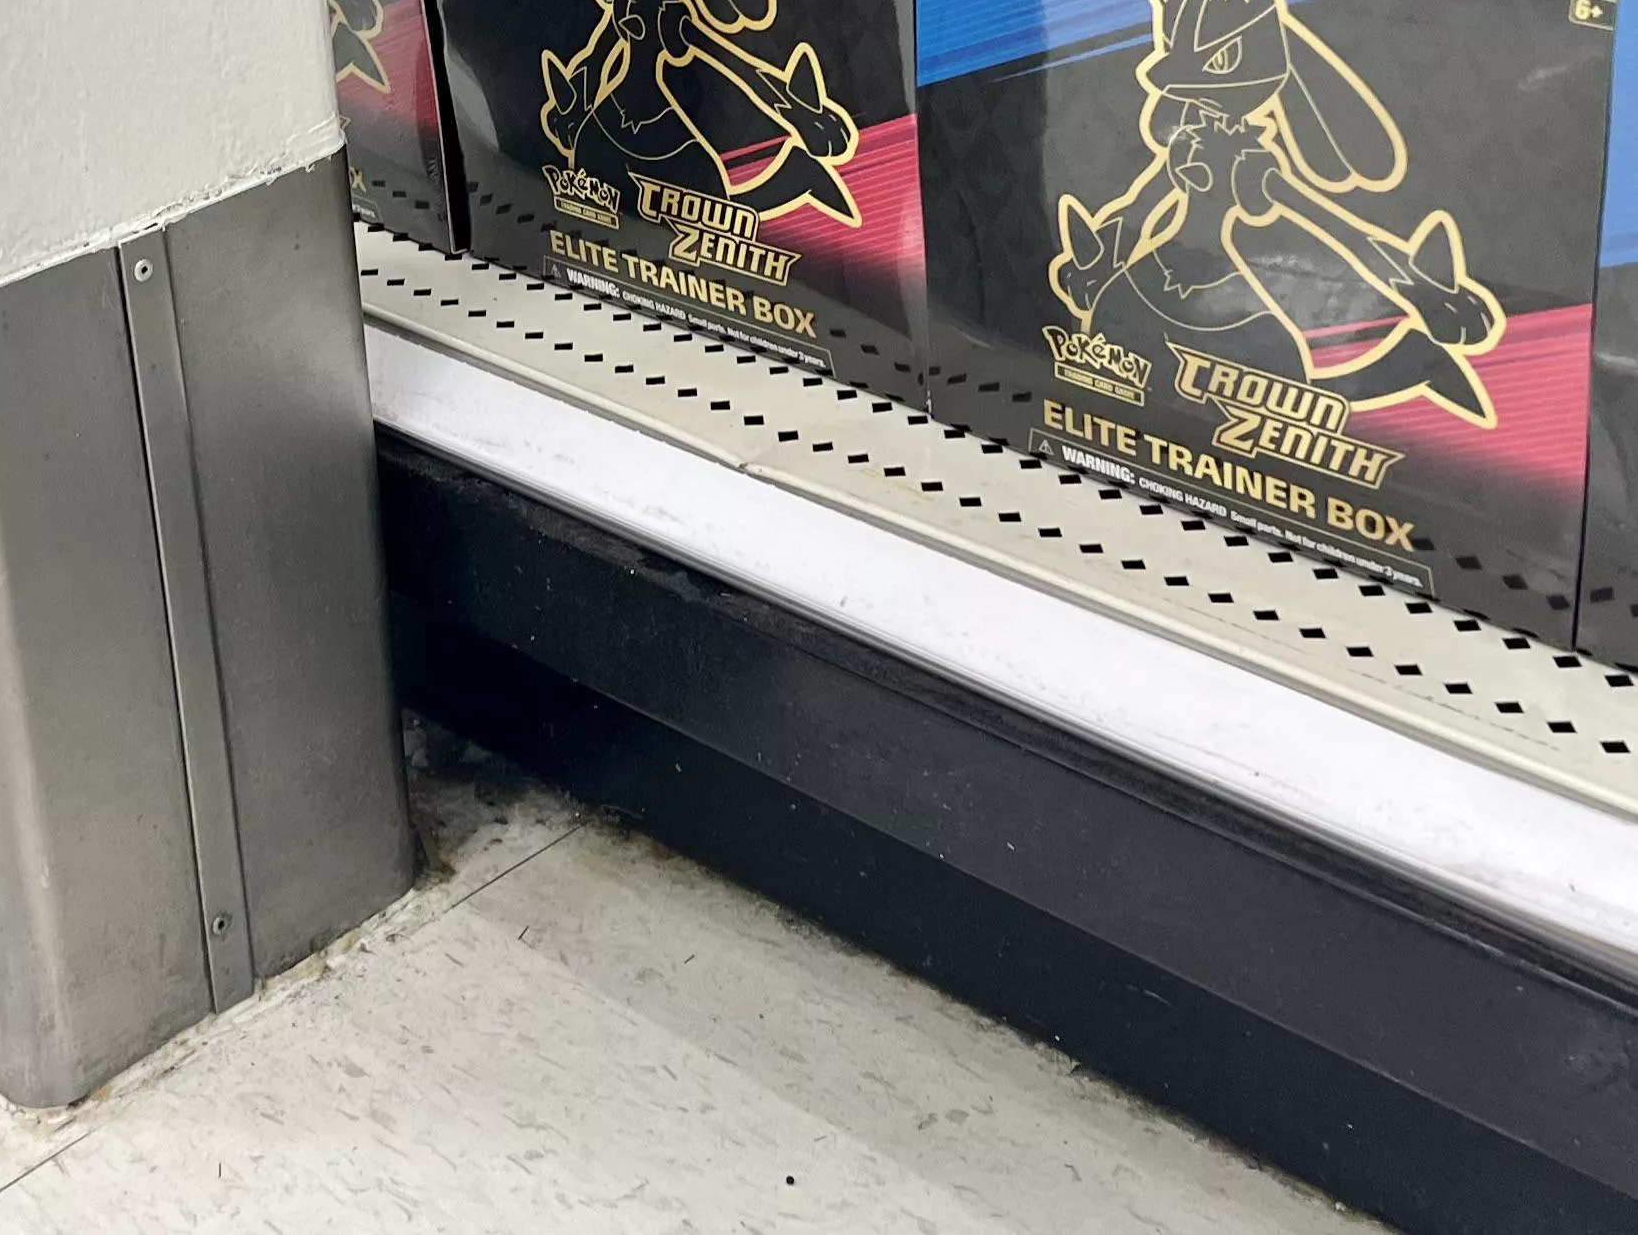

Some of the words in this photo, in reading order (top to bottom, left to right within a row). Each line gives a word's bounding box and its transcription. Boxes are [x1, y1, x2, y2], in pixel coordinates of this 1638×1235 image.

[638, 180, 759, 239] CROWN
[550, 230, 619, 273] ELITE
[622, 254, 747, 316] TRAINER
[753, 295, 816, 338] BOX
[672, 226, 791, 282] ZENITH
[566, 268, 620, 298] WARNING:
[655, 302, 686, 319] HAZARD
[1180, 352, 1347, 433] CROWN
[1043, 399, 1136, 457] ELITE
[1144, 434, 1315, 519] TRAINER
[1327, 496, 1415, 552] BOX
[1218, 408, 1386, 483] ZENITH
[1061, 445, 1136, 485] WARNING:
[1138, 477, 1183, 501] CHOKING
[1185, 492, 1227, 518] HAZARD
[1230, 510, 1256, 528] Small
[1257, 521, 1283, 538] parts.
[1284, 529, 1302, 544] Not
[1302, 537, 1317, 549] for
[1316, 541, 1356, 563] children
[1356, 557, 1383, 574] under
[1394, 571, 1423, 589] years.
